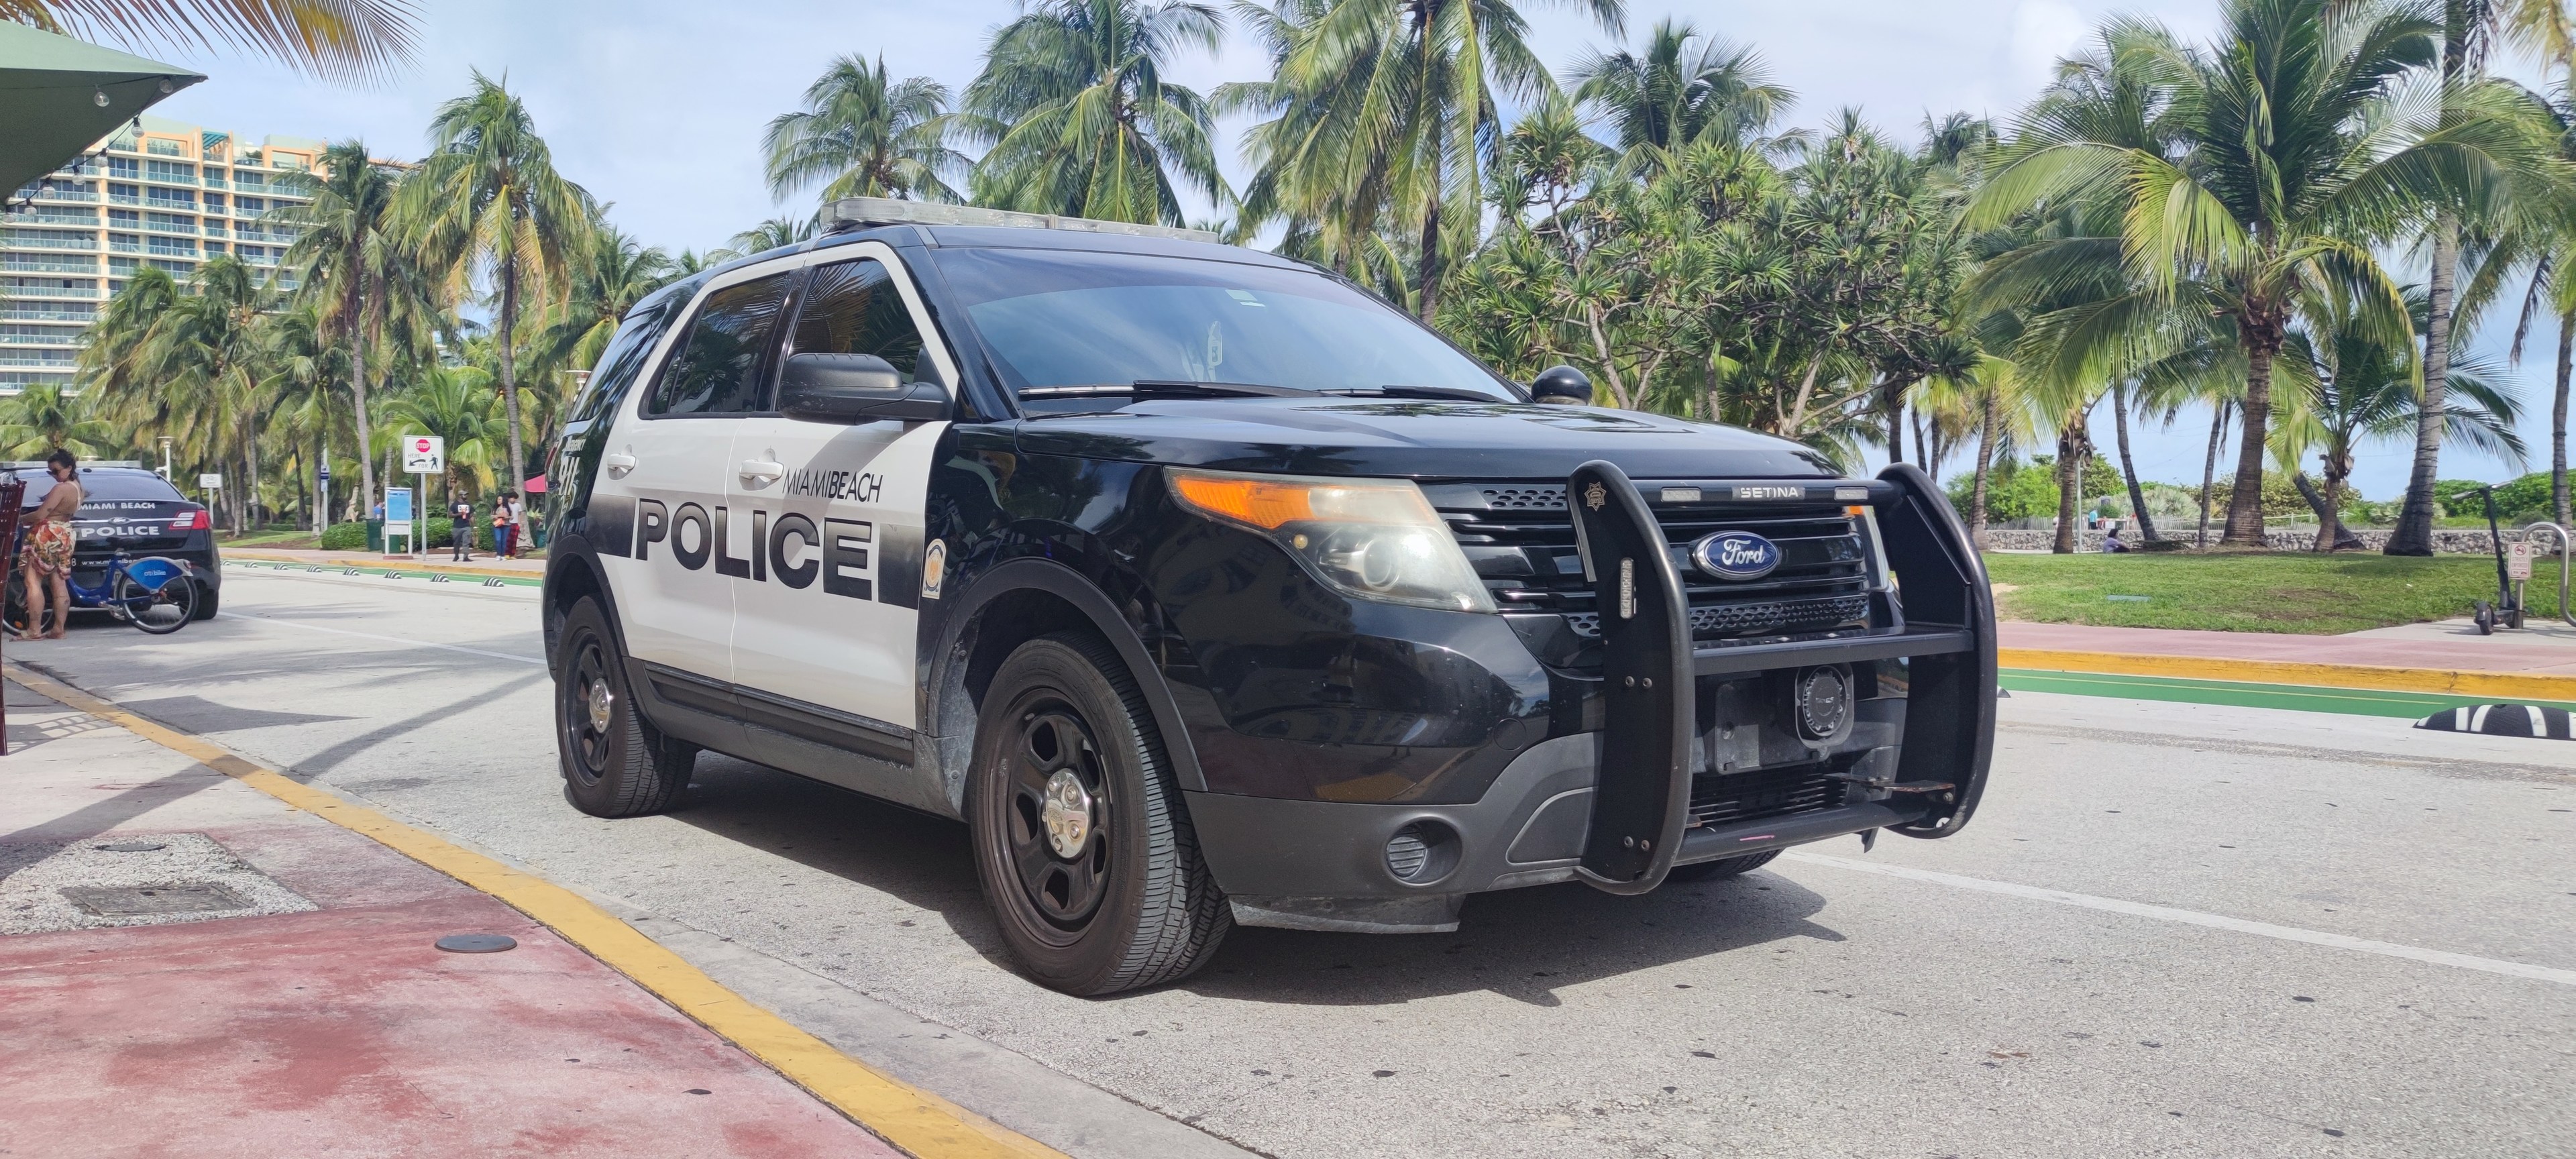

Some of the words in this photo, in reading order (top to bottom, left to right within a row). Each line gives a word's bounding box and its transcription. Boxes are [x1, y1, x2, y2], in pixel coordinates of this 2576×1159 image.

[558, 456, 580, 496] 911
[1740, 487, 1799, 498] SETINA
[78, 502, 115, 510] MIAMI
[81, 526, 160, 538] POLICE
[635, 498, 872, 601] POLICE
[1722, 539, 1765, 565] Ford
